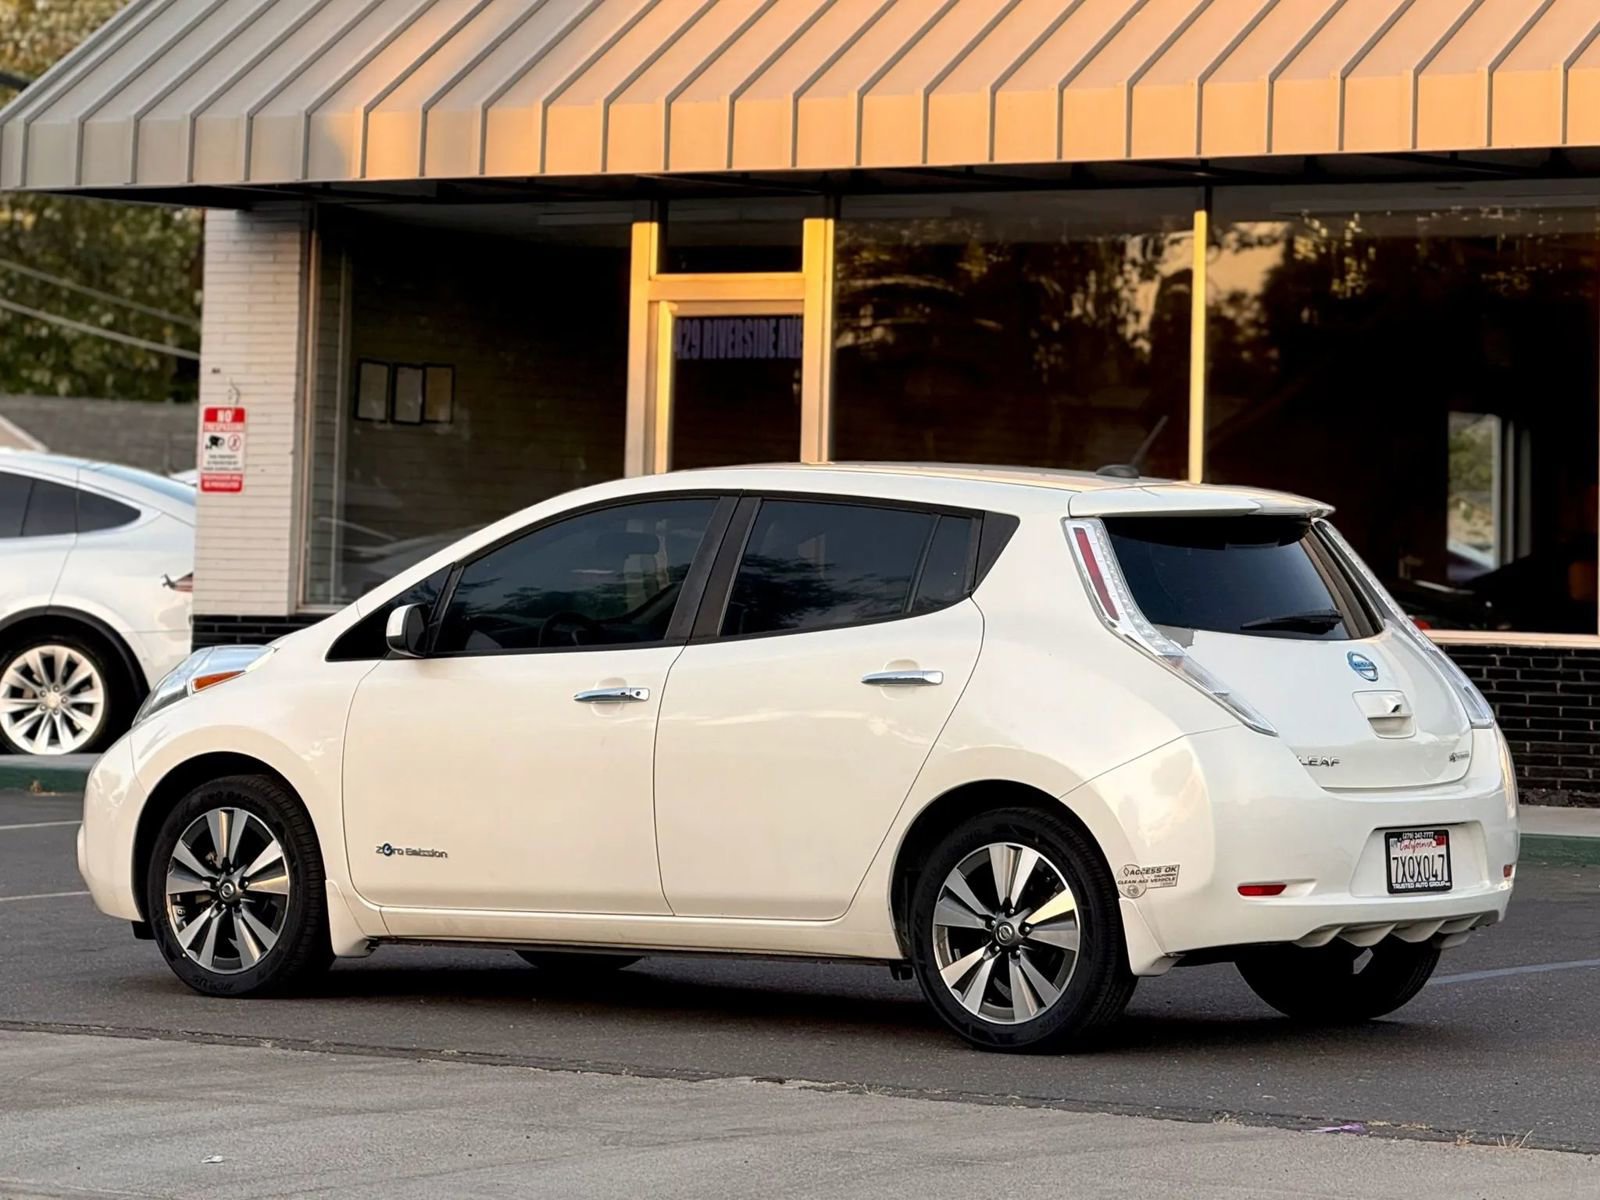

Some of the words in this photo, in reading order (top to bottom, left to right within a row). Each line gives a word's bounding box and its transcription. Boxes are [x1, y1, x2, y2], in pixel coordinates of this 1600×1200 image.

[703, 318, 777, 358] RIVERSIDE
[216, 408, 234, 423] NO
[1299, 755, 1340, 767] LEAF
[1399, 838, 1437, 854] California
[1129, 868, 1162, 876] ACCESS
[1392, 854, 1445, 883] 7XQX047
